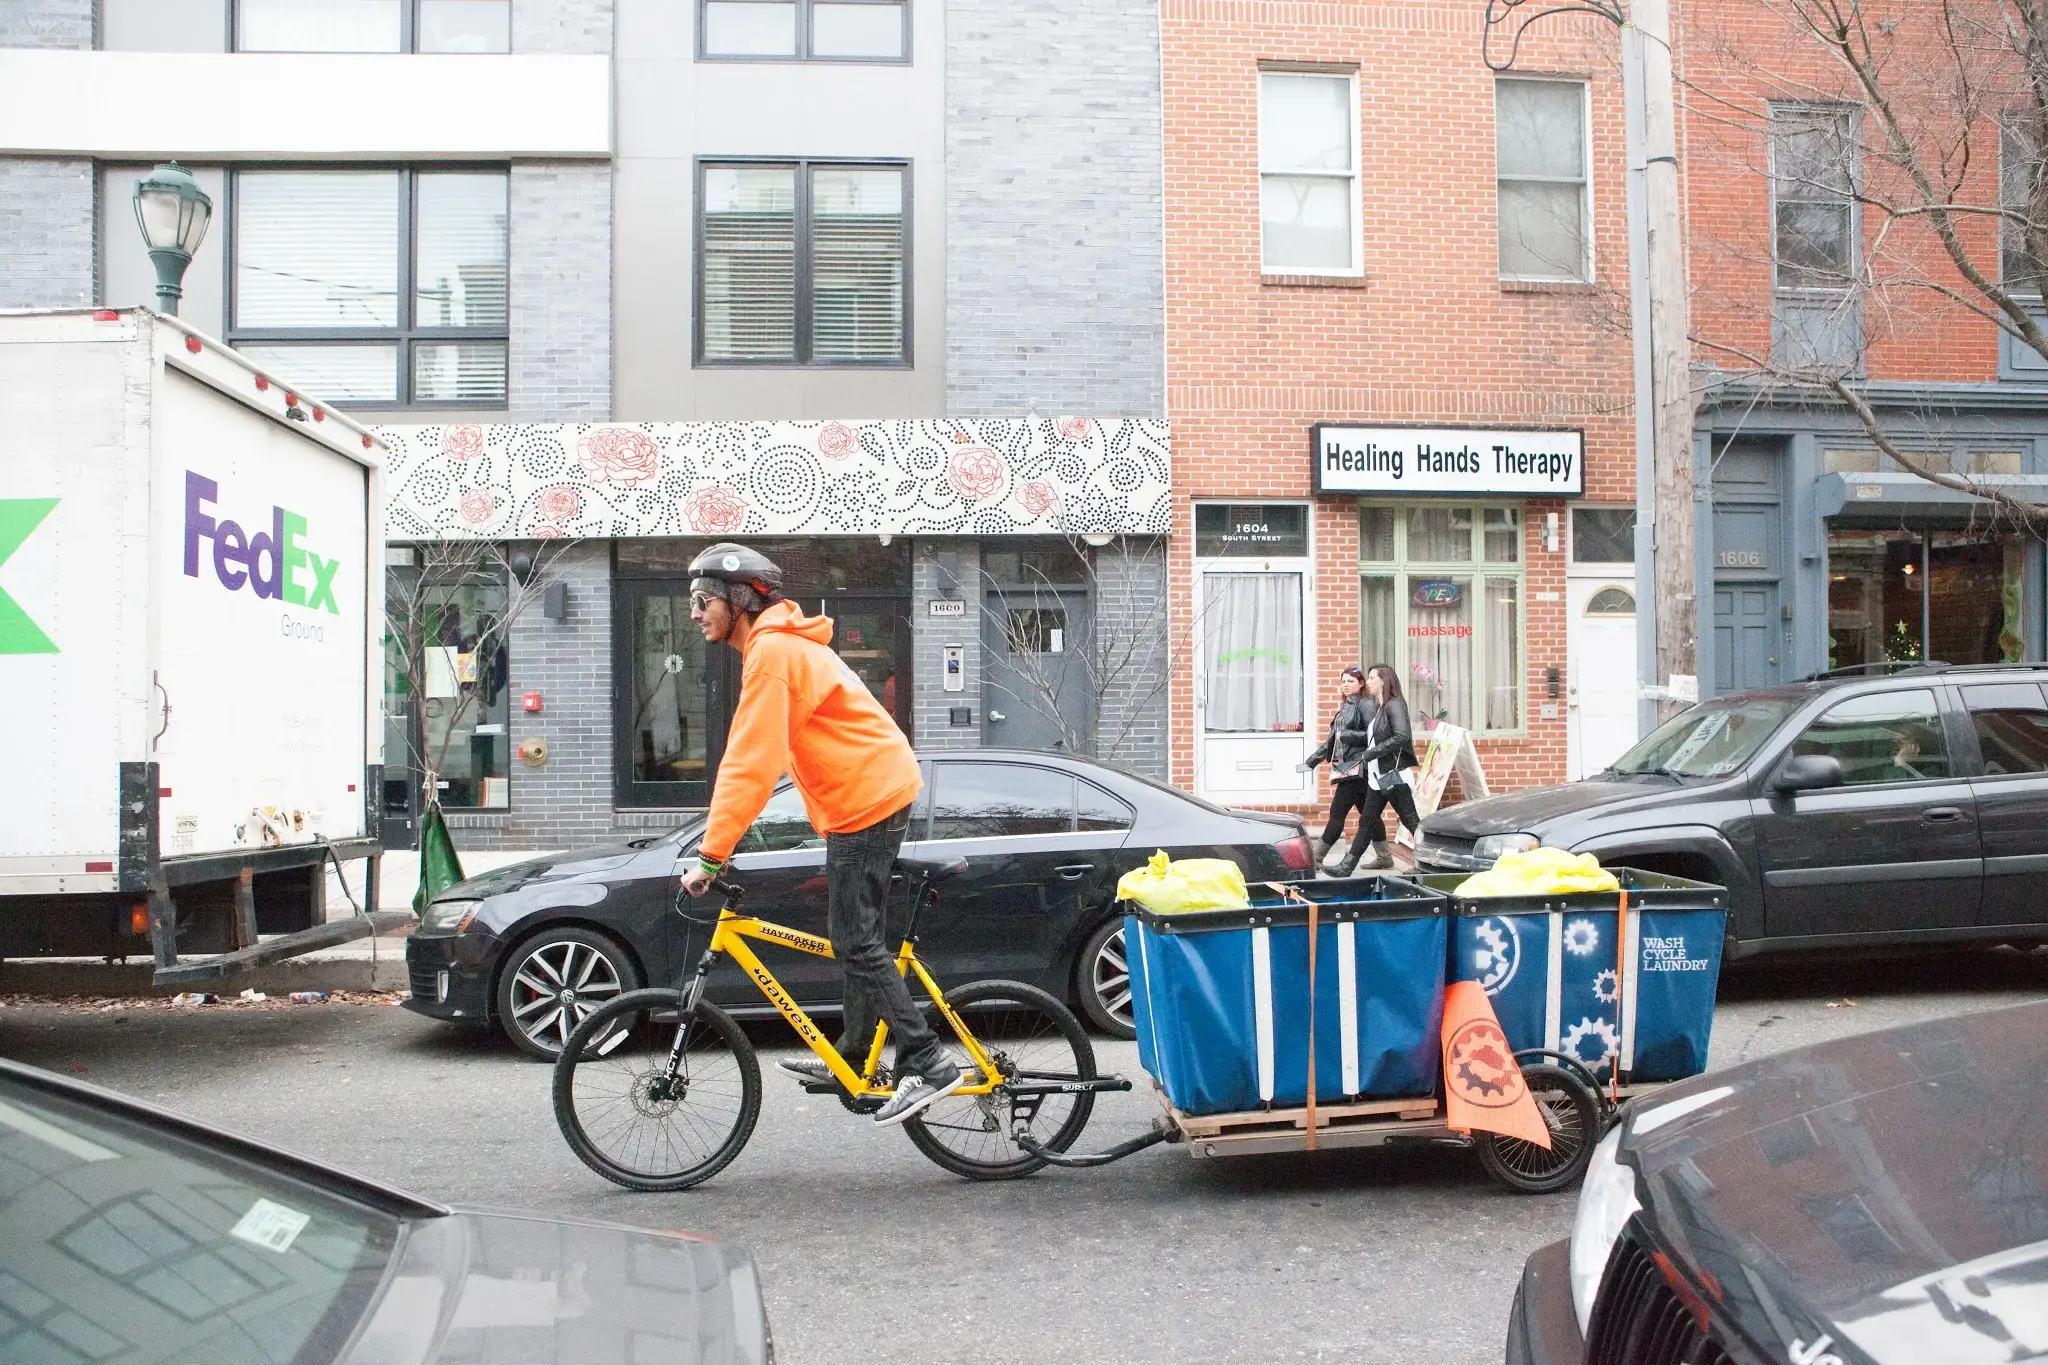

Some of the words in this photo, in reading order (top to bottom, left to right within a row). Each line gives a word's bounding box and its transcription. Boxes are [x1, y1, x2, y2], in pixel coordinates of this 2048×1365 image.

[1326, 442, 1403, 480] Healing
[1417, 444, 1480, 473] Hands
[1492, 445, 1573, 482] Therapy
[1236, 523, 1268, 533] 1604
[183, 469, 341, 616] FedEx
[1719, 551, 1759, 566] 1606
[281, 614, 324, 643] Ground
[1407, 624, 1473, 638] massage
[760, 926, 827, 950] HAYMAKER
[1643, 937, 1684, 948] WASH
[1643, 949, 1686, 959] CYCLE
[1643, 960, 1708, 971] LAUNDRY
[758, 973, 812, 1036] dawes
